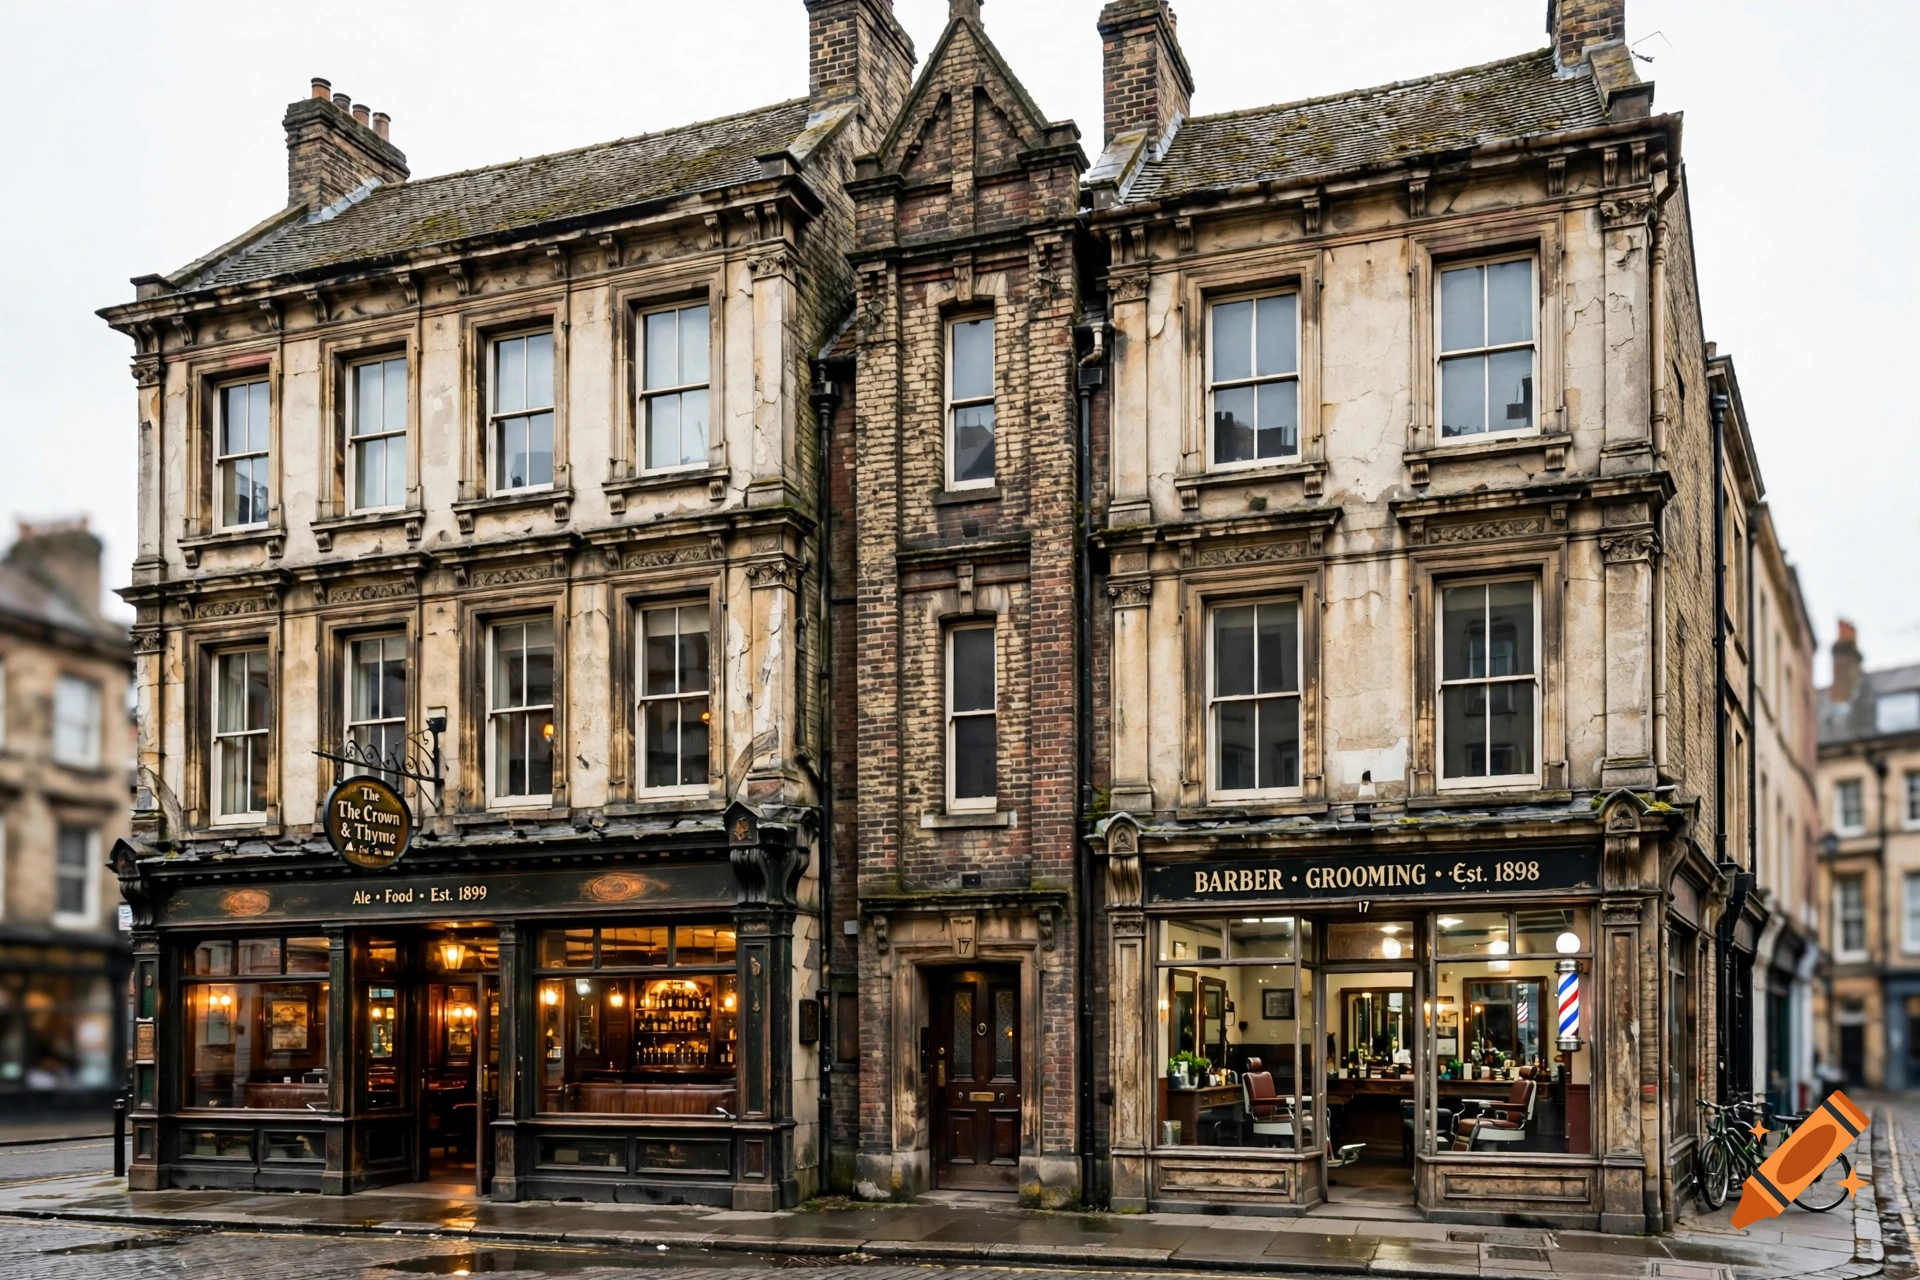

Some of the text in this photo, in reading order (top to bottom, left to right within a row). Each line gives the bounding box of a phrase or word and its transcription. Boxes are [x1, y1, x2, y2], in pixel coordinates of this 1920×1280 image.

[361, 787, 380, 802] The
[337, 800, 400, 826] The Crown
[340, 822, 396, 845] & Thyme
[1194, 860, 1540, 893] BARBER GROOMING Est. 1898
[352, 885, 487, 905] Ale Food Est. 1899
[1358, 901, 1370, 913] 17
